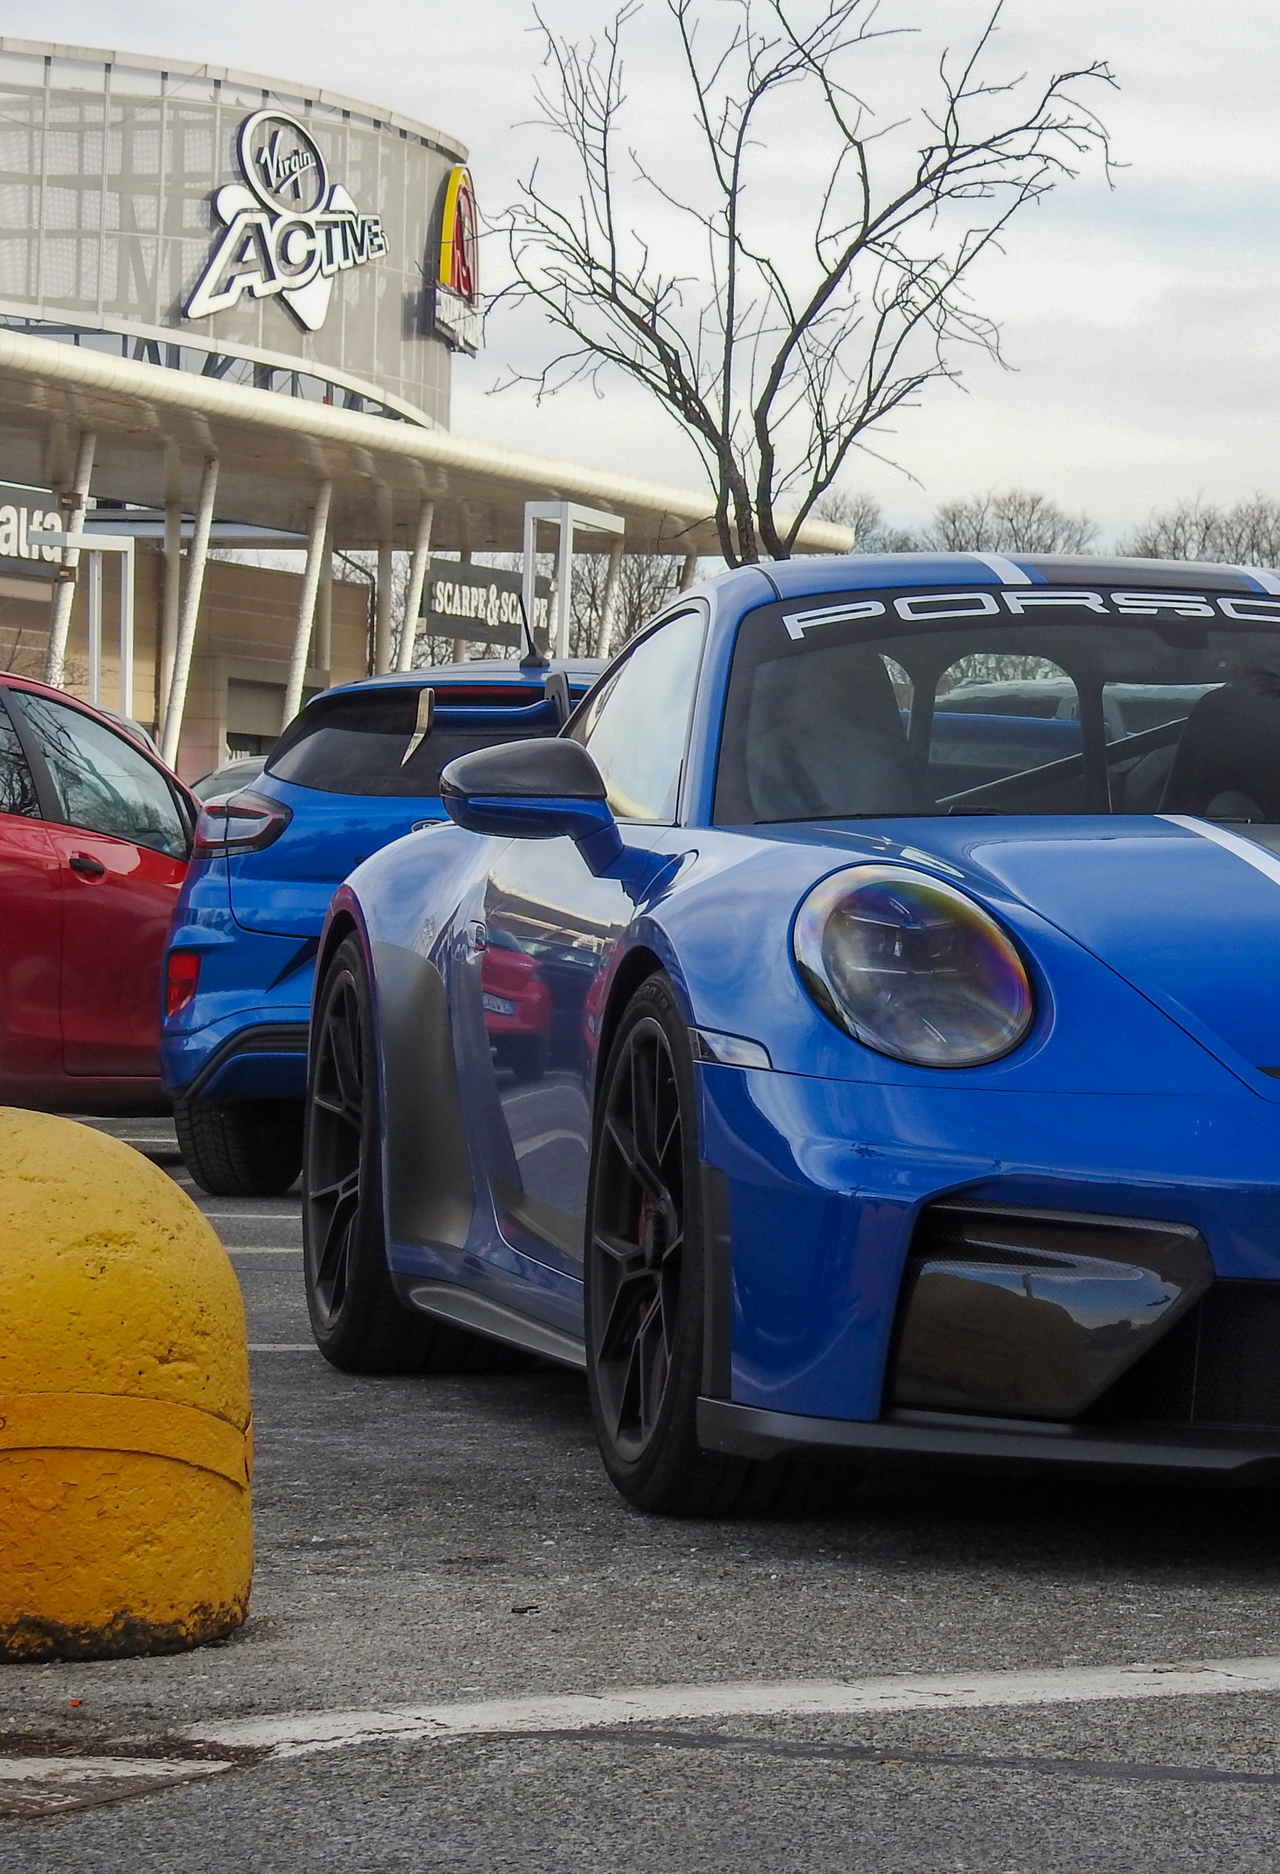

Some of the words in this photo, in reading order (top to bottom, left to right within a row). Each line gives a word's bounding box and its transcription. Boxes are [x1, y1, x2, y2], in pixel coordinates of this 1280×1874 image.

[258, 130, 316, 198] Virgin
[184, 211, 391, 318] ACTIVE
[435, 581, 548, 629] SCARPE&SCAPE
